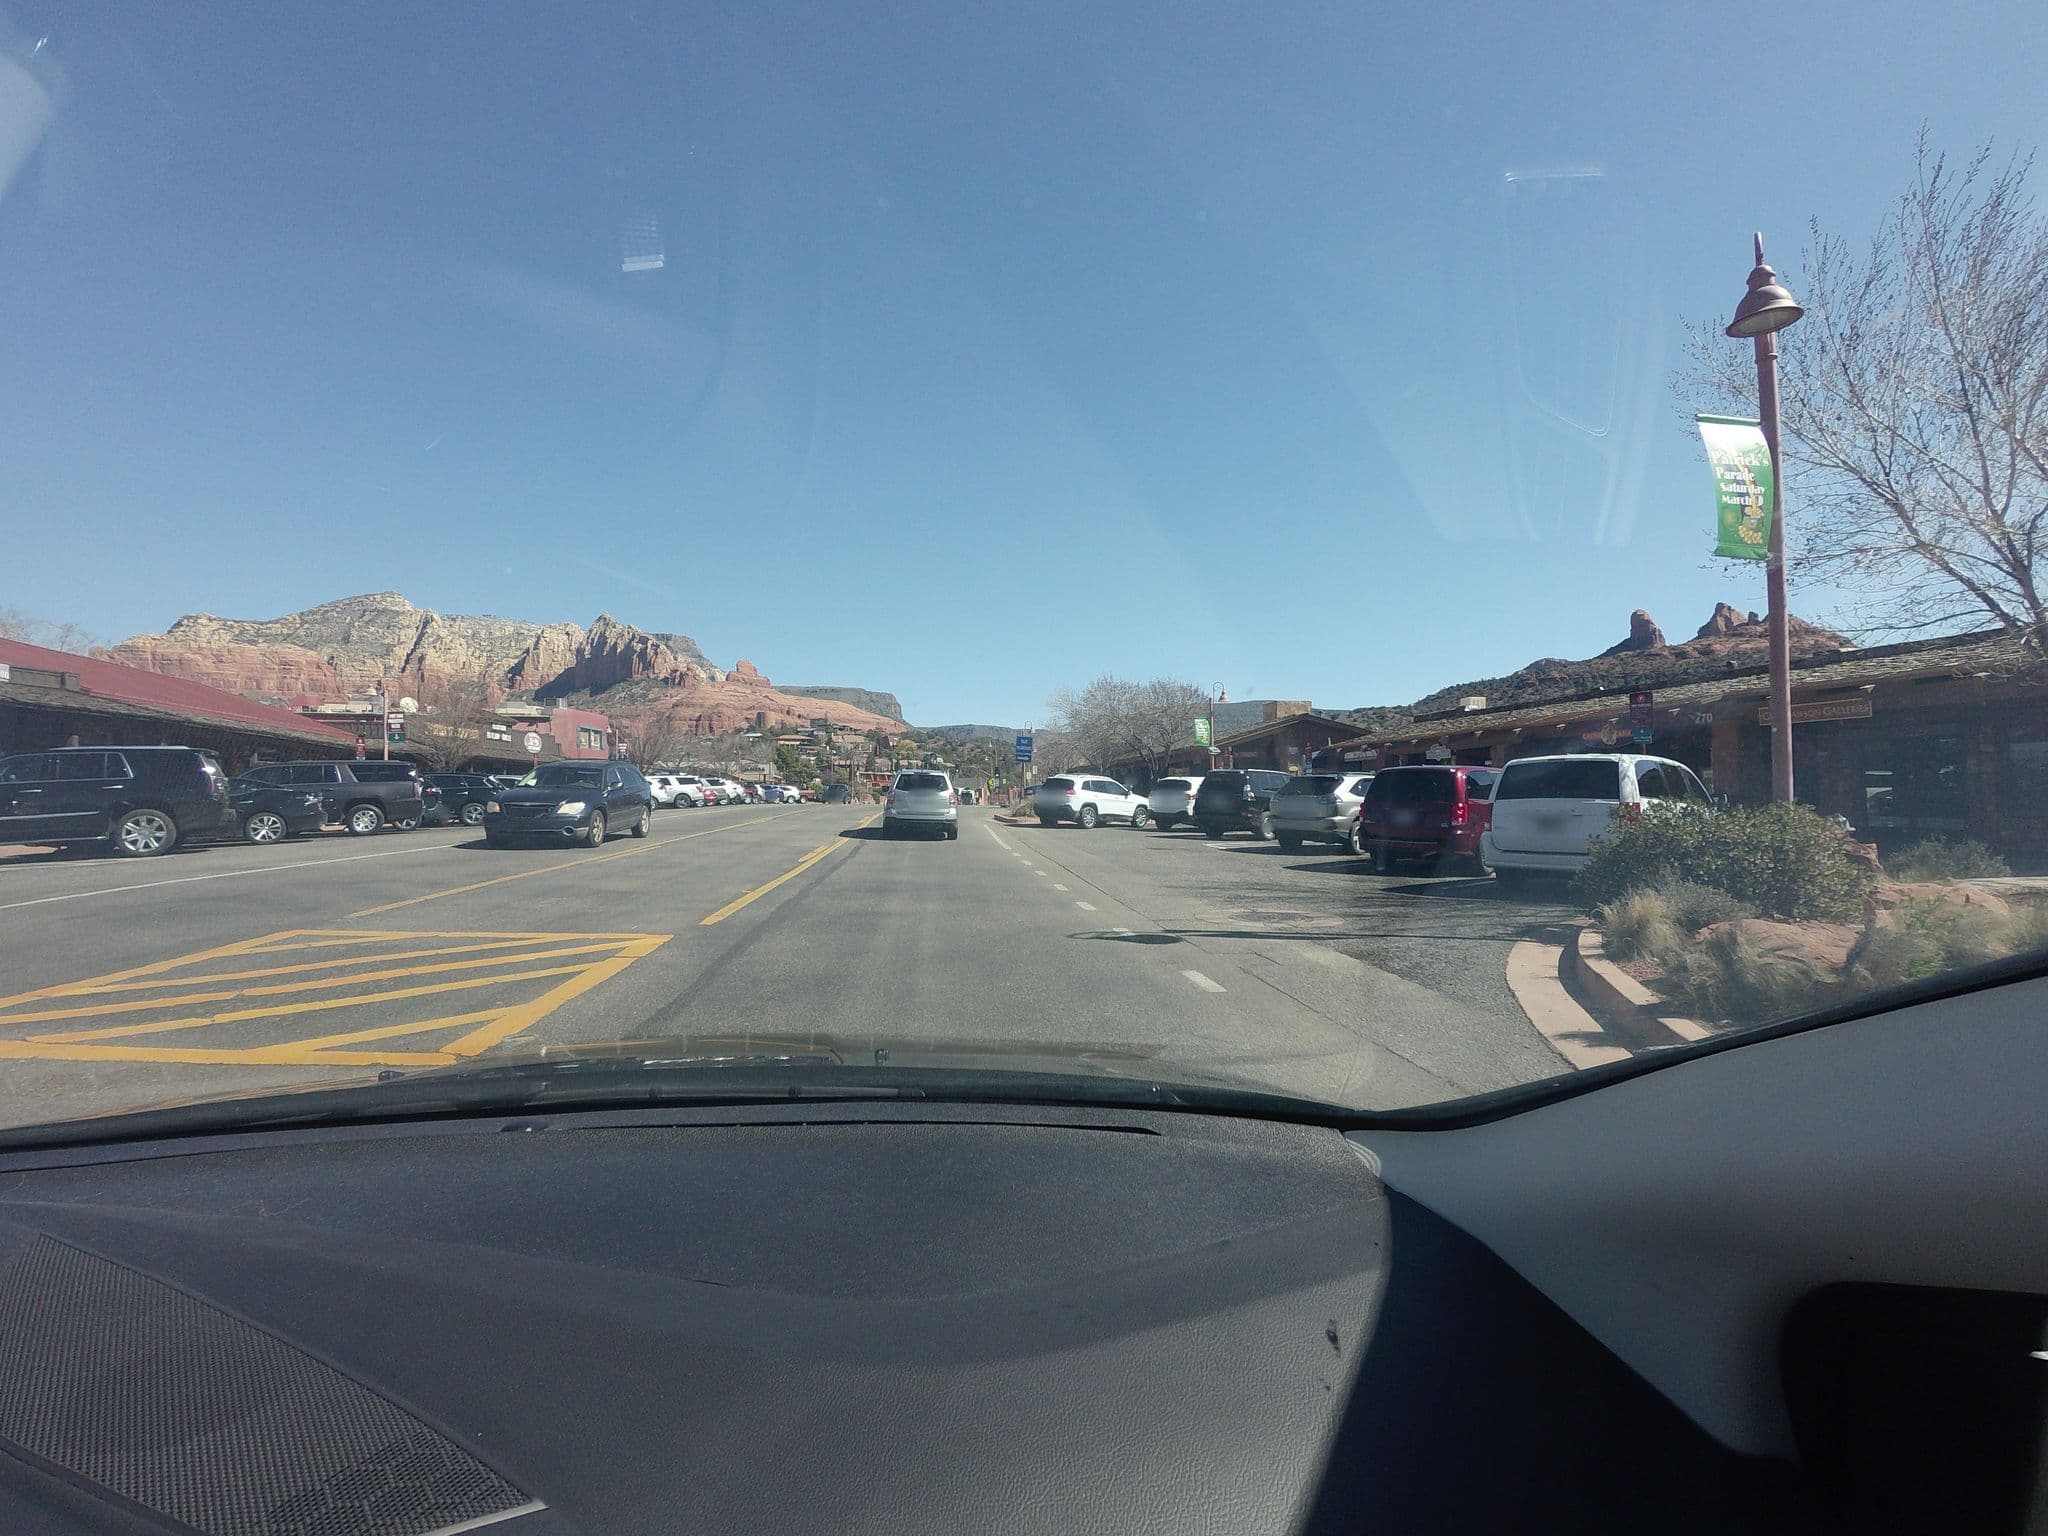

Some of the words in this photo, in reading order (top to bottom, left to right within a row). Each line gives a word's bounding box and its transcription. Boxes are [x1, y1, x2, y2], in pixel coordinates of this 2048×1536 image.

[1711, 449, 1769, 466] Patrick's
[1716, 467, 1755, 481] Parade
[1720, 482, 1765, 494] Saturday
[1722, 494, 1752, 505] March
[1823, 703, 1869, 716] GALLERIES
[1695, 712, 1713, 724] 270
